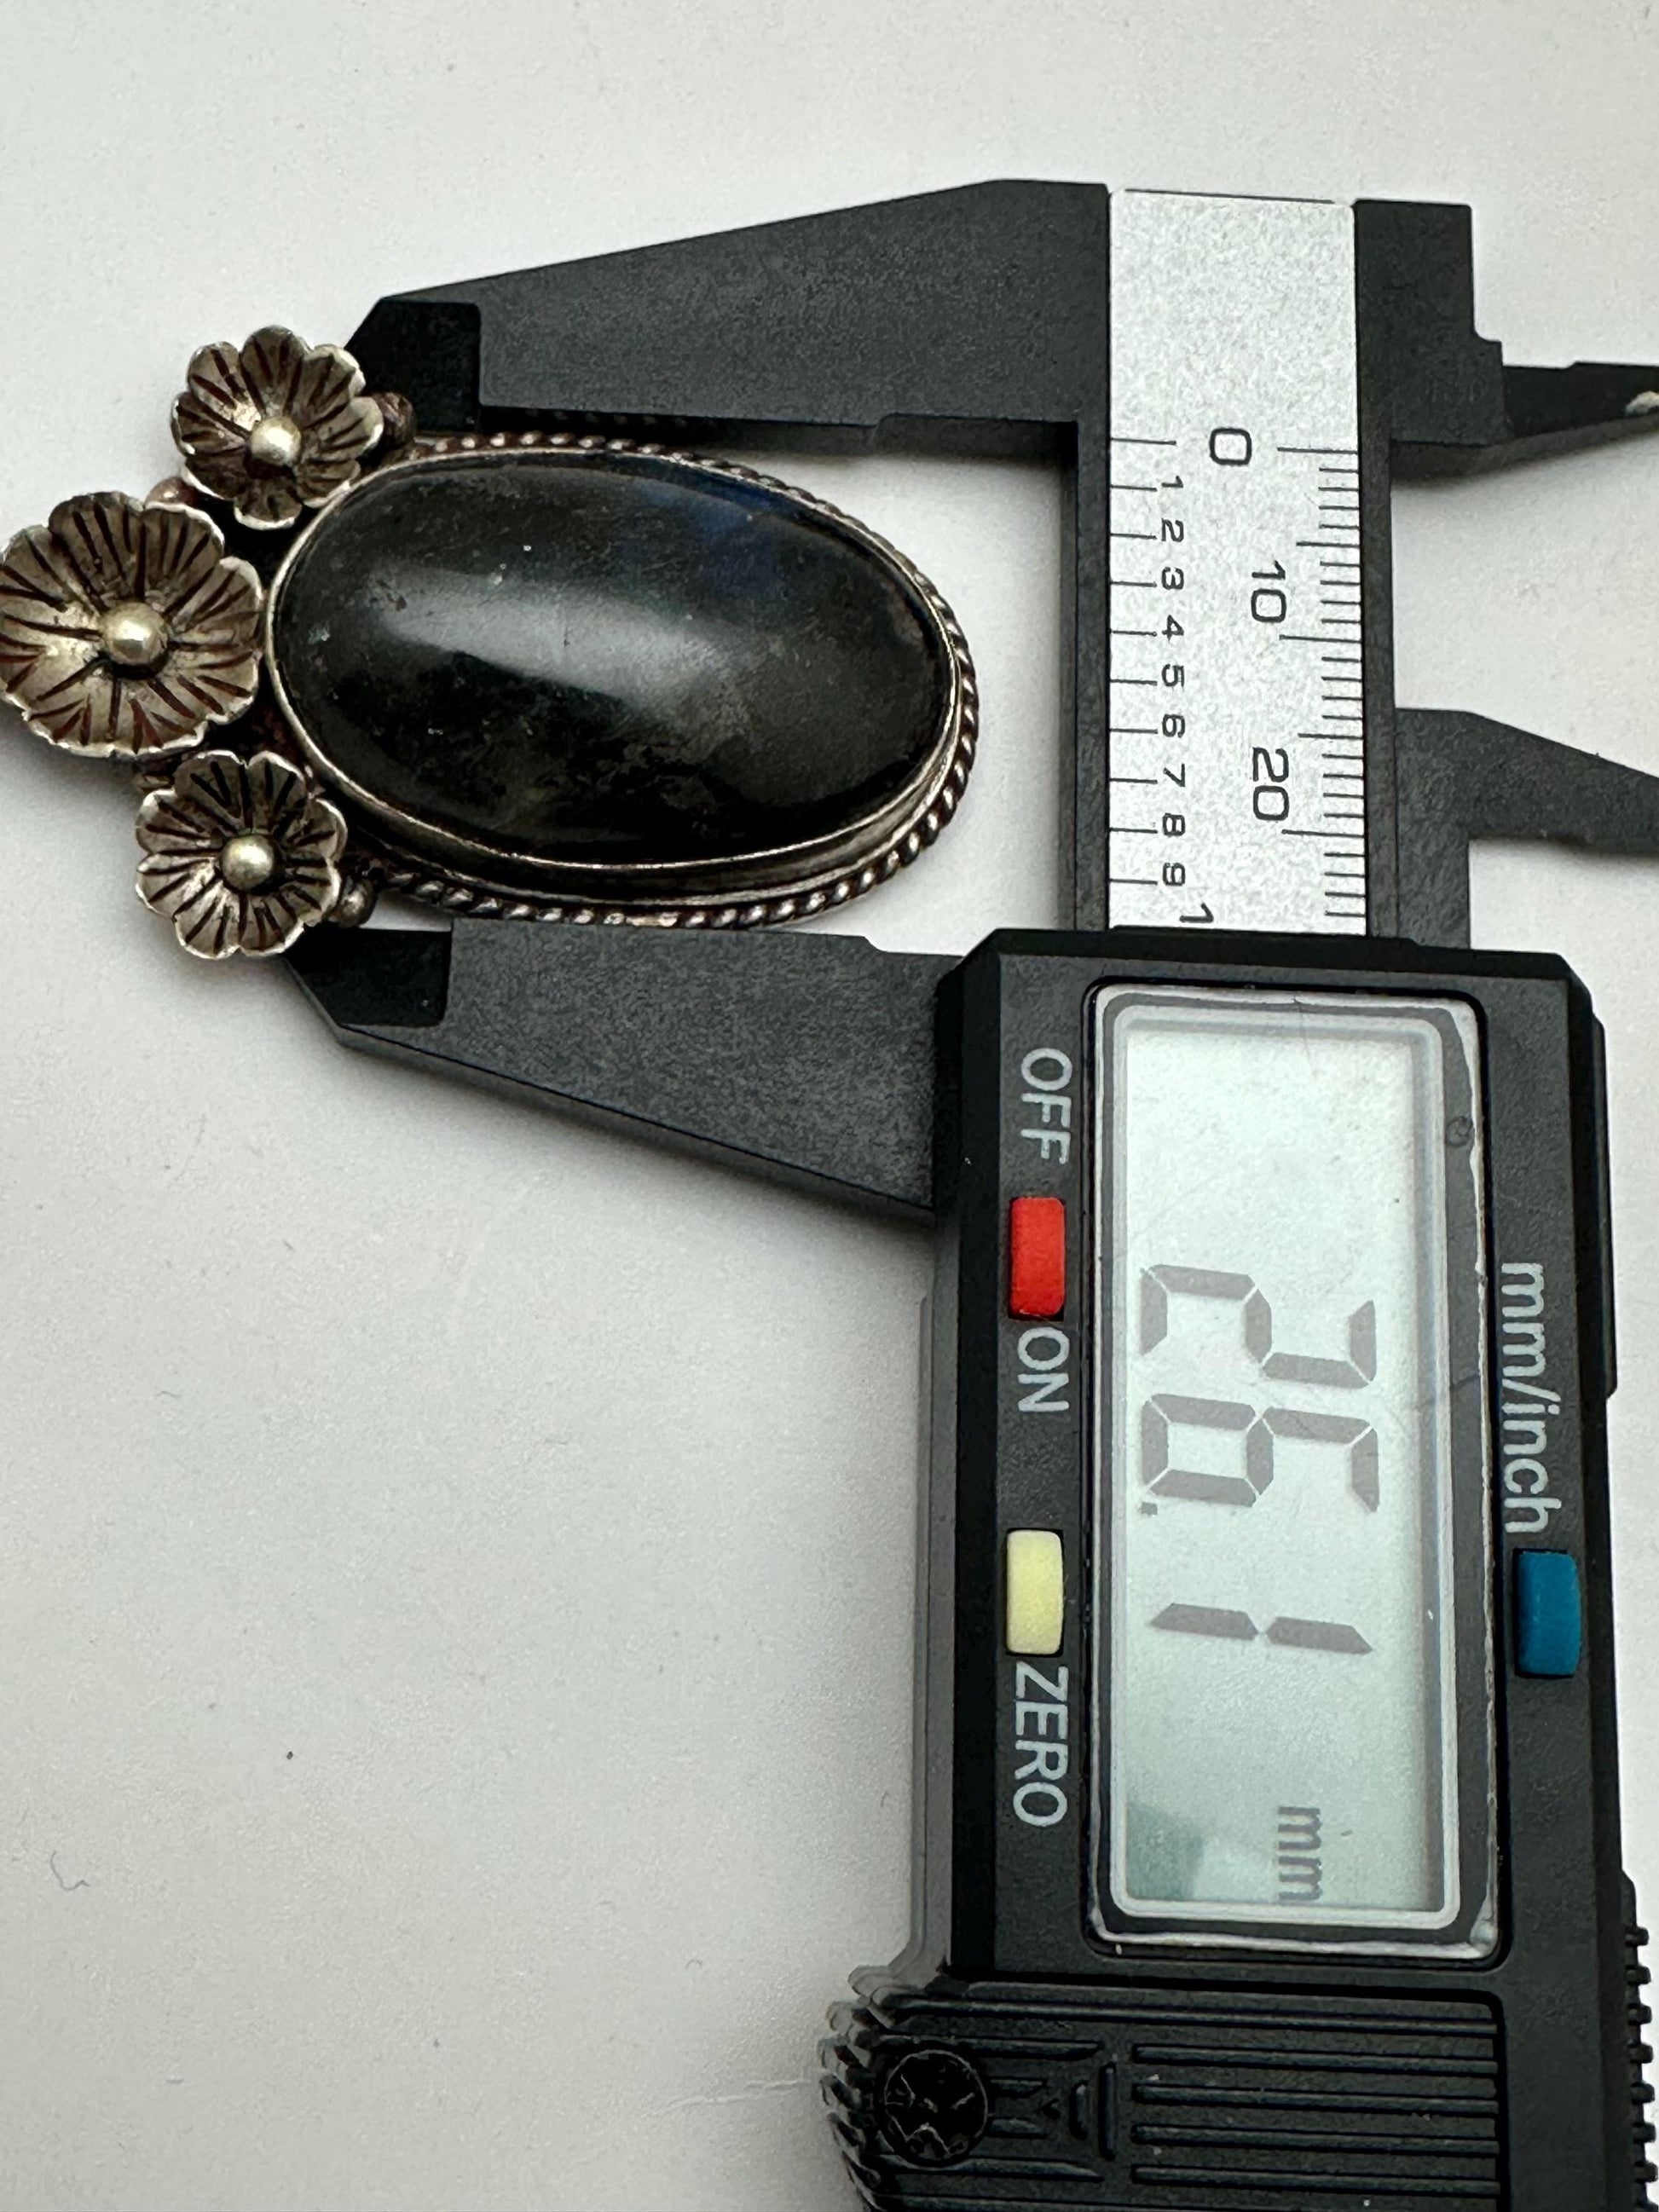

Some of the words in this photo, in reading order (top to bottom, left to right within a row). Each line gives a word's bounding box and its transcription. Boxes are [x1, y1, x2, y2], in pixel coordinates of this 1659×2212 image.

[1209, 427, 1252, 466] 0
[1161, 476, 1184, 488] 1
[1161, 518, 1184, 542] 2
[1161, 567, 1184, 590] 3
[1251, 560, 1286, 624] 10
[1162, 615, 1184, 640] 4
[1161, 664, 1185, 687] 5
[1162, 713, 1186, 738] 6
[1163, 764, 1186, 787] 7
[1252, 747, 1289, 822] 20
[1162, 813, 1186, 837] 8
[1162, 863, 1186, 887] 9
[1179, 903, 1214, 923] 1
[1020, 1048, 1072, 1164] OFF
[1018, 1327, 1069, 1412] ON
[1501, 1262, 1562, 1533] mm/inch
[1138, 1264, 1379, 1656] 26.1
[1277, 1805, 1322, 1903] mm
[1013, 1661, 1068, 1827] ZERO
